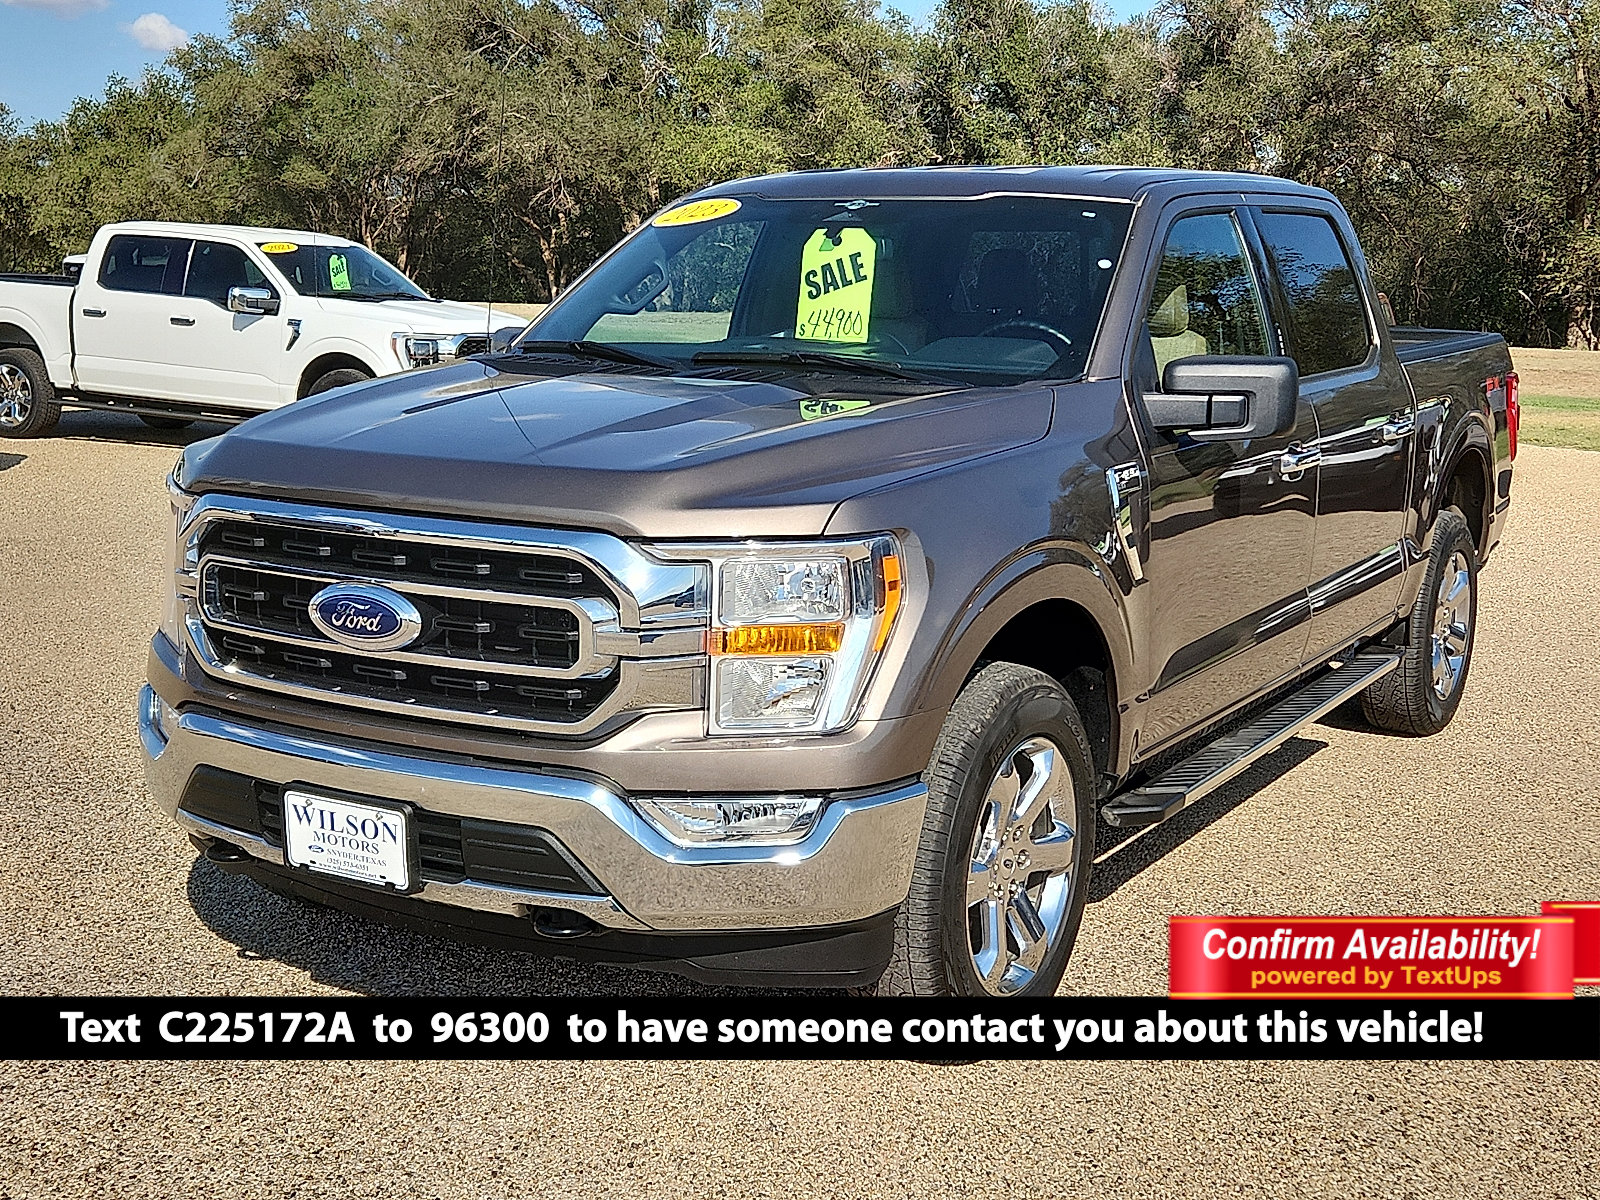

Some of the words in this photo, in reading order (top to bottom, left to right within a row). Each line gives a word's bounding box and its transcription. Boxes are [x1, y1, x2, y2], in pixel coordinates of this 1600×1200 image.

[331, 259, 346, 277] SALE
[804, 252, 868, 300] SALE
[331, 600, 382, 632] Ford
[292, 803, 399, 845] WILSON
[313, 830, 380, 855] MOTORS
